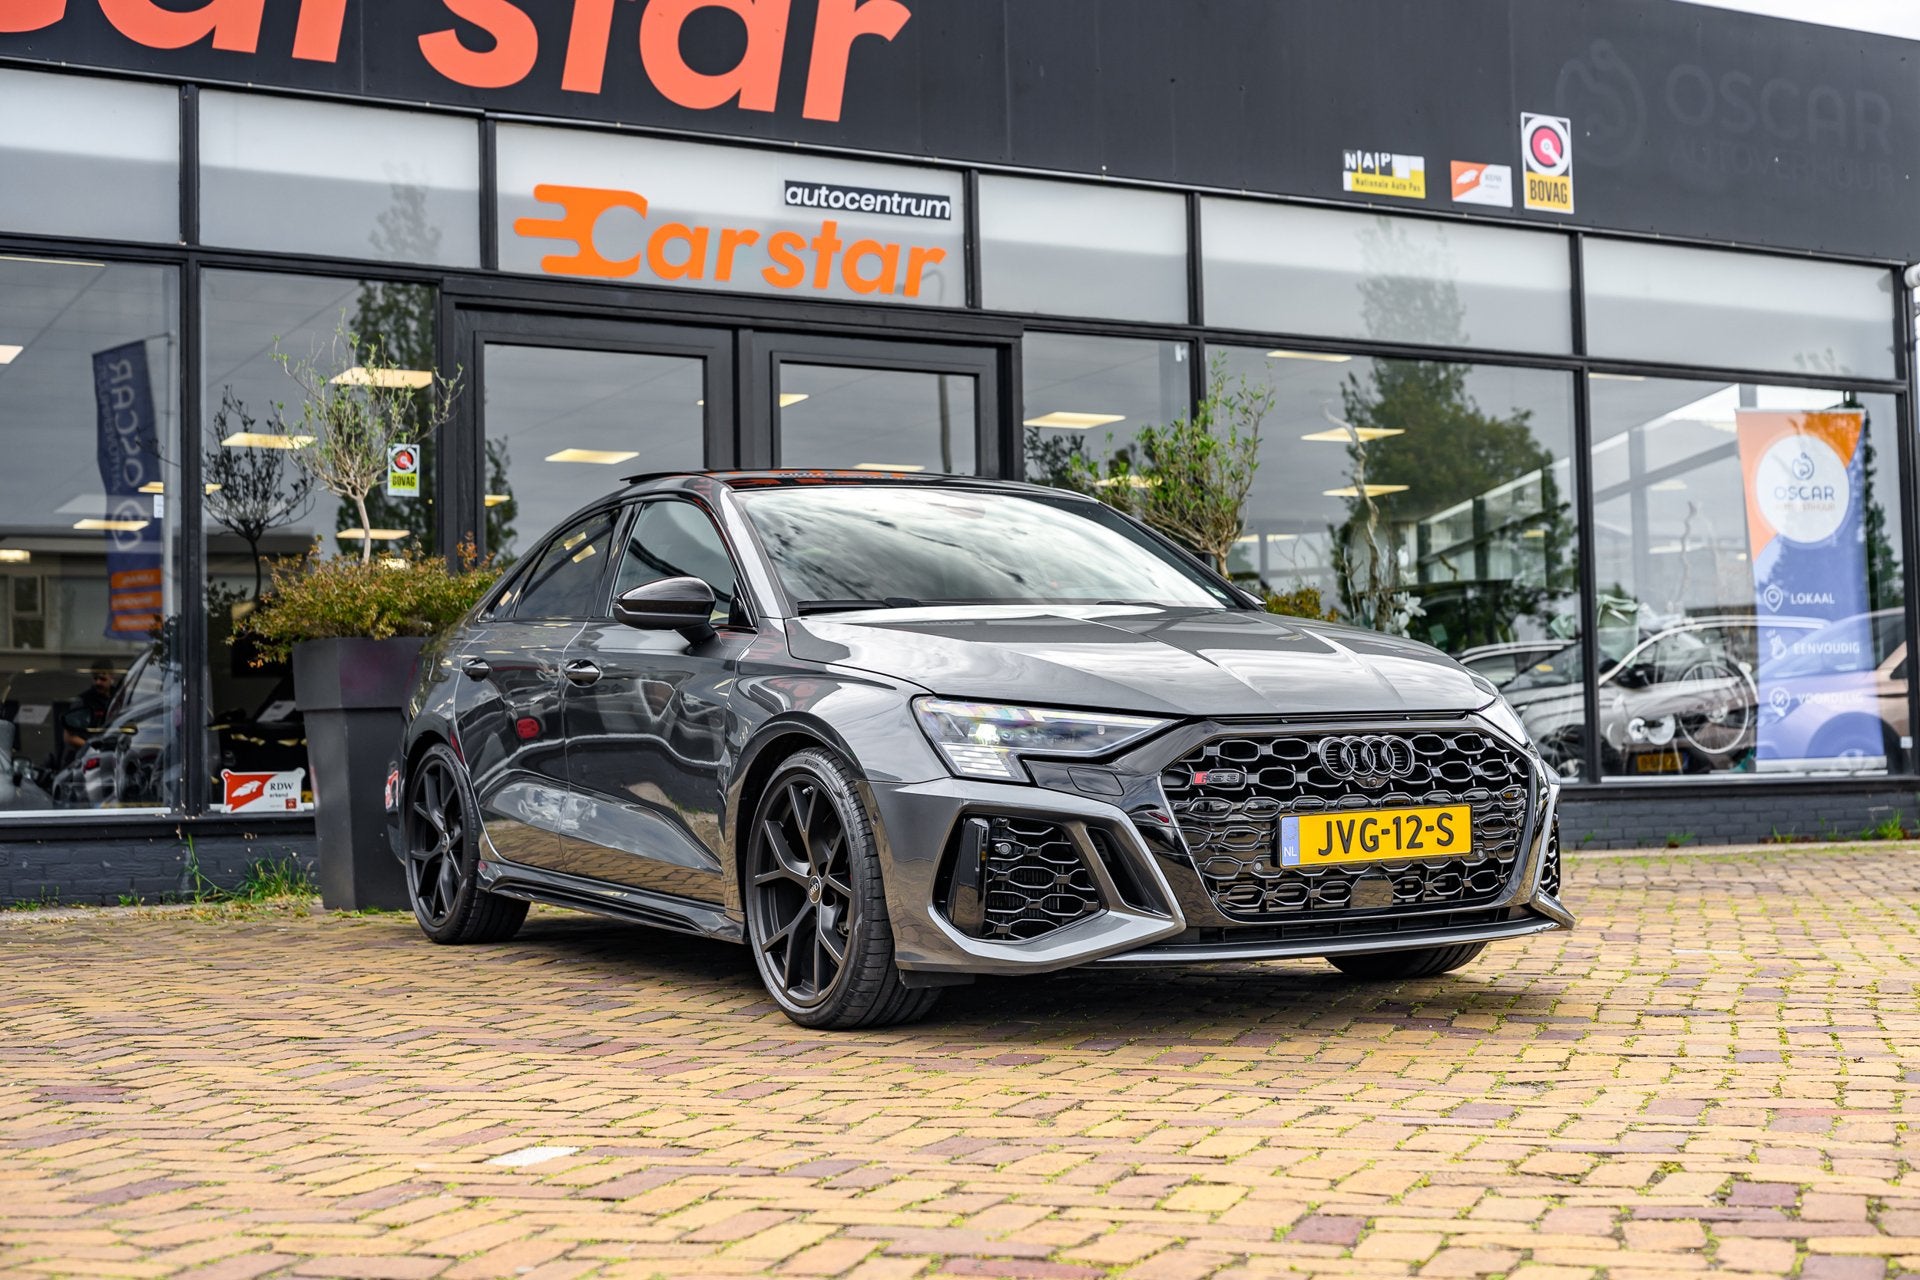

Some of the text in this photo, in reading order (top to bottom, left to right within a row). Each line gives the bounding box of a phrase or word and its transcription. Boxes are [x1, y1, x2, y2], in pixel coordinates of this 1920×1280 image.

[0, 0, 911, 122] star
[1355, 178, 1421, 191] Nationale Auto Pas
[1530, 179, 1568, 204] BOVAG
[785, 185, 951, 219] autocentrum
[512, 183, 947, 298] Carstar
[1775, 486, 1834, 500] OSCAR
[1790, 592, 1835, 604] LOKAAL
[1793, 642, 1860, 654] EENVOUDIG
[270, 782, 293, 790] RDW
[1283, 812, 1455, 857] NL JVG-12-S
